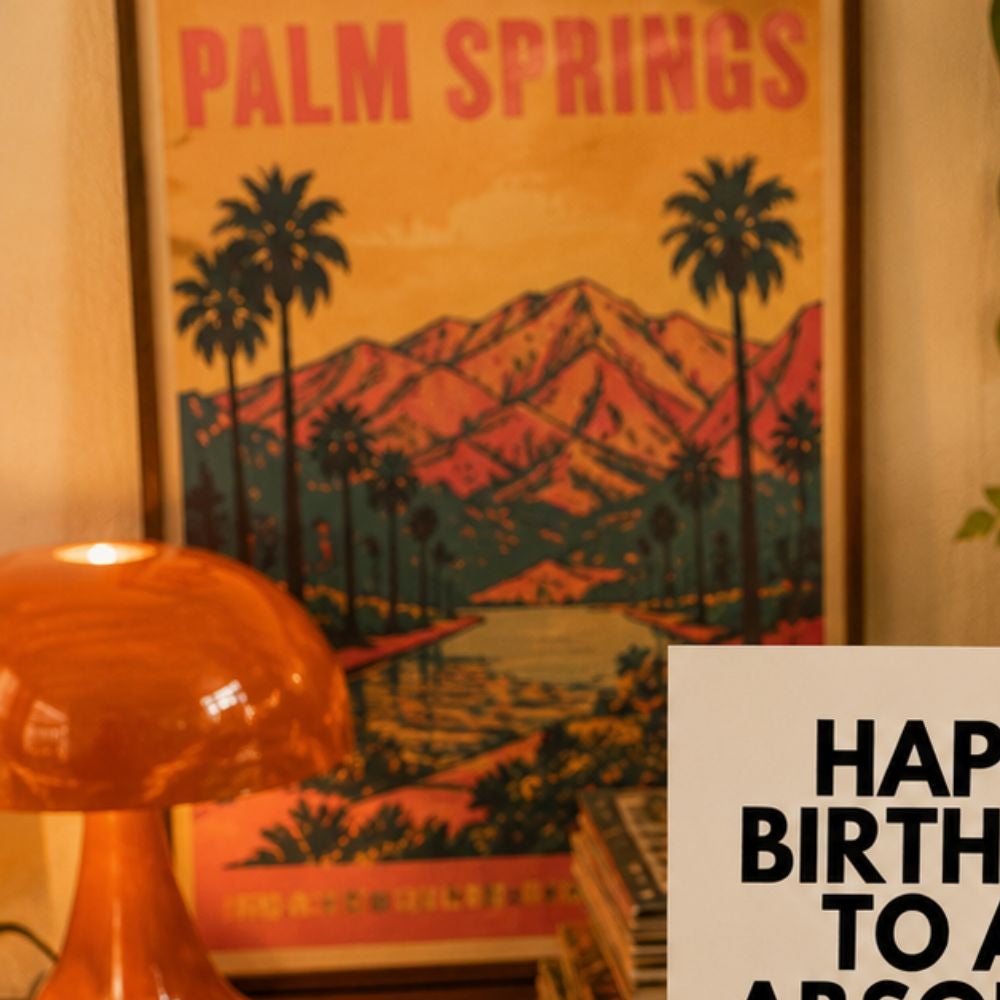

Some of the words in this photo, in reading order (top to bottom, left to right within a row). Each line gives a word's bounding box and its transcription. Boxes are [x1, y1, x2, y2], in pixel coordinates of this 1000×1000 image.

[179, 22, 411, 129] PALM
[443, 10, 809, 121] SPRINGS
[822, 894, 949, 971] TO
